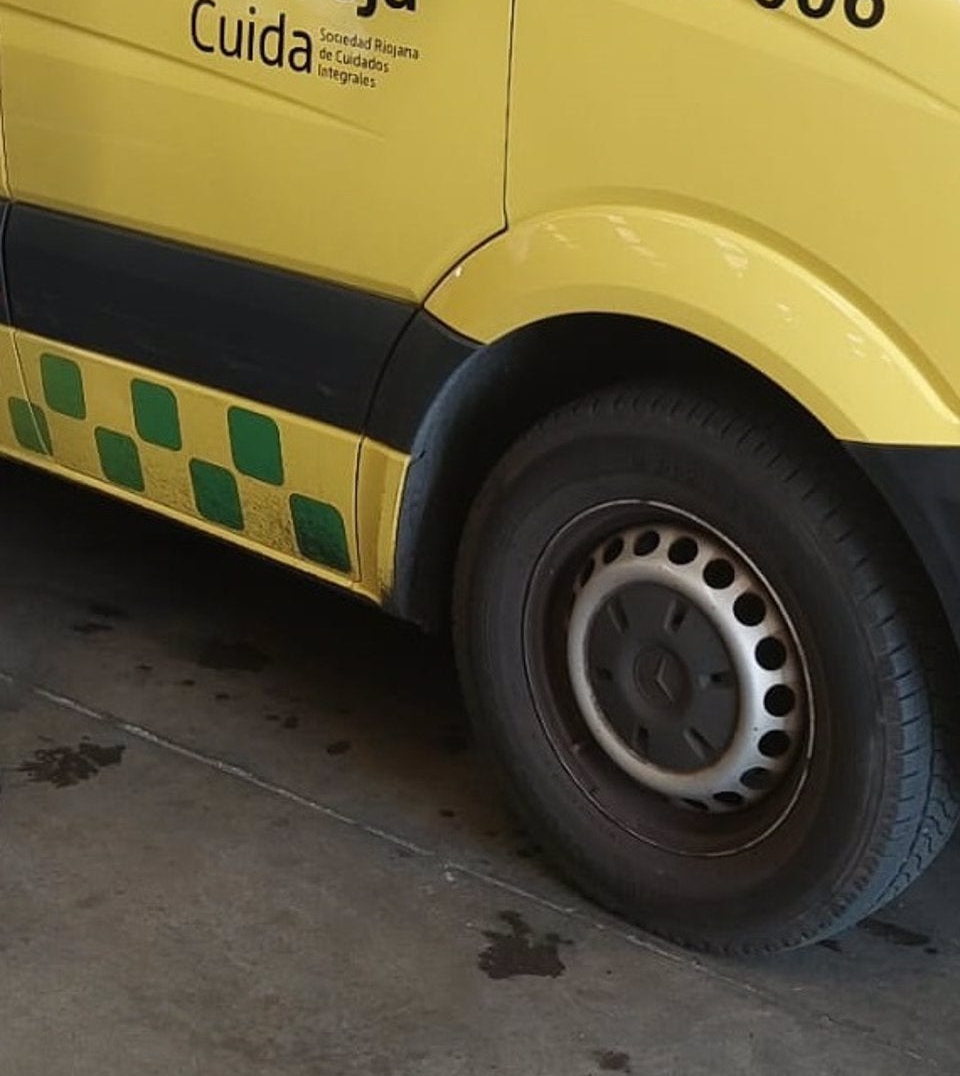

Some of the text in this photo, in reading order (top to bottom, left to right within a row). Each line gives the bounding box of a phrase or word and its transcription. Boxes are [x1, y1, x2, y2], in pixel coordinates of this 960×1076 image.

[319, 27, 419, 60] Sociedad Riojana
[319, 47, 390, 73] de Cuidados
[317, 63, 377, 88] Integrales
